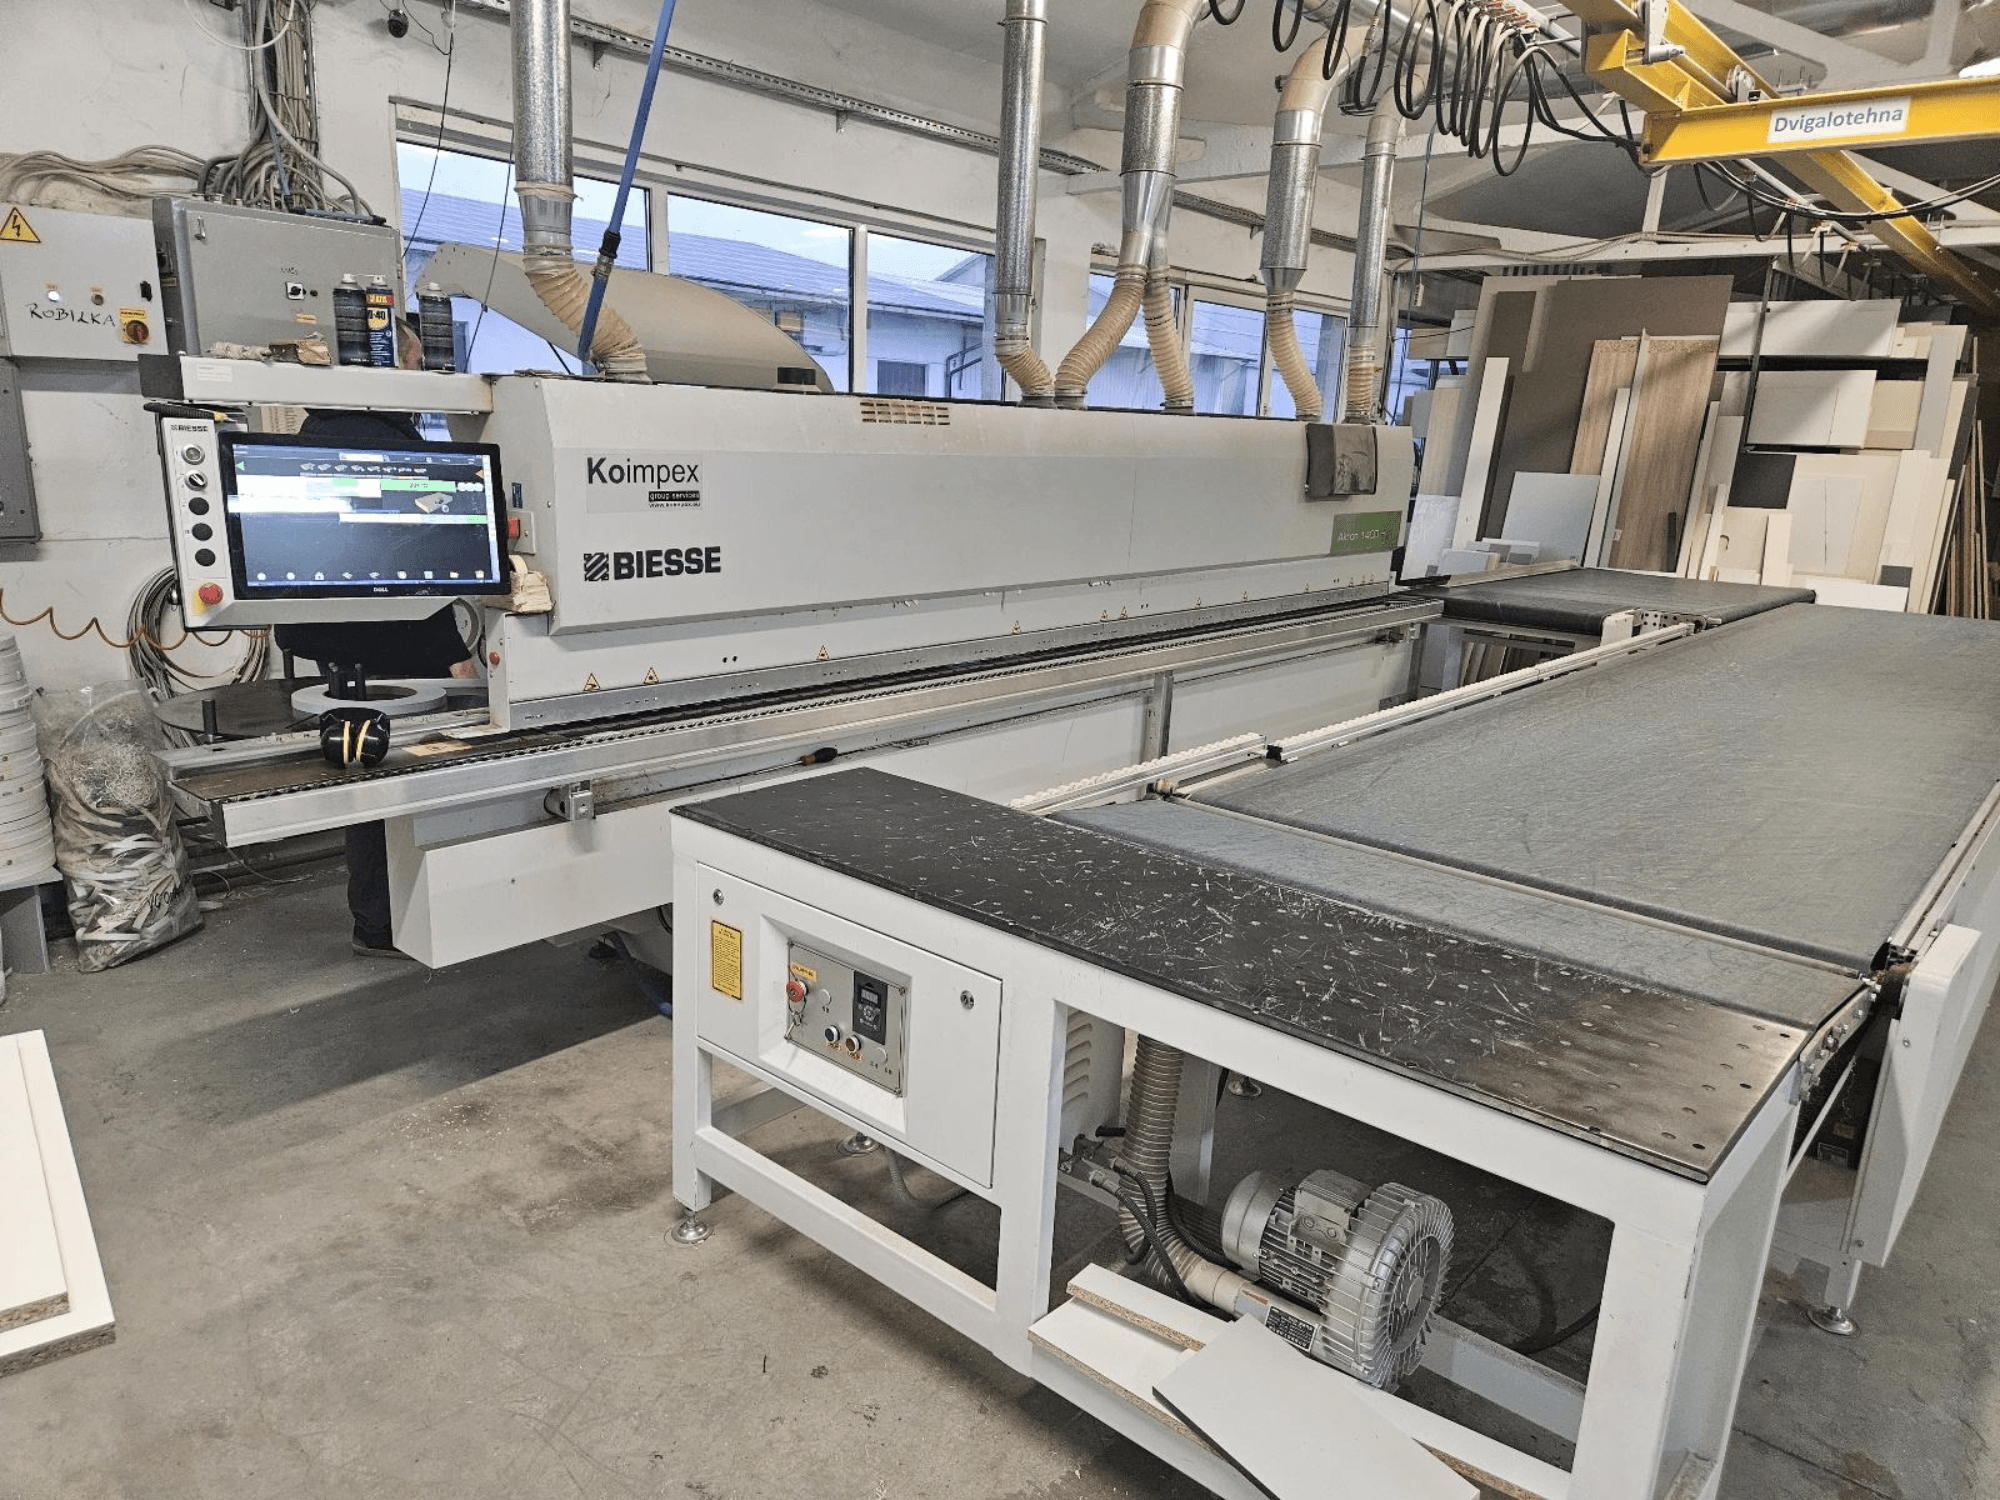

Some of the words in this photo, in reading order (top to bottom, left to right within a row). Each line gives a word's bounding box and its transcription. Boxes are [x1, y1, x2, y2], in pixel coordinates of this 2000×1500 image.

[1774, 106, 1904, 134] Dvigalotehna
[178, 424, 209, 432] BIESSE
[586, 456, 700, 490] Koimpex
[649, 492, 670, 501] group
[613, 545, 722, 581] BIESSE
